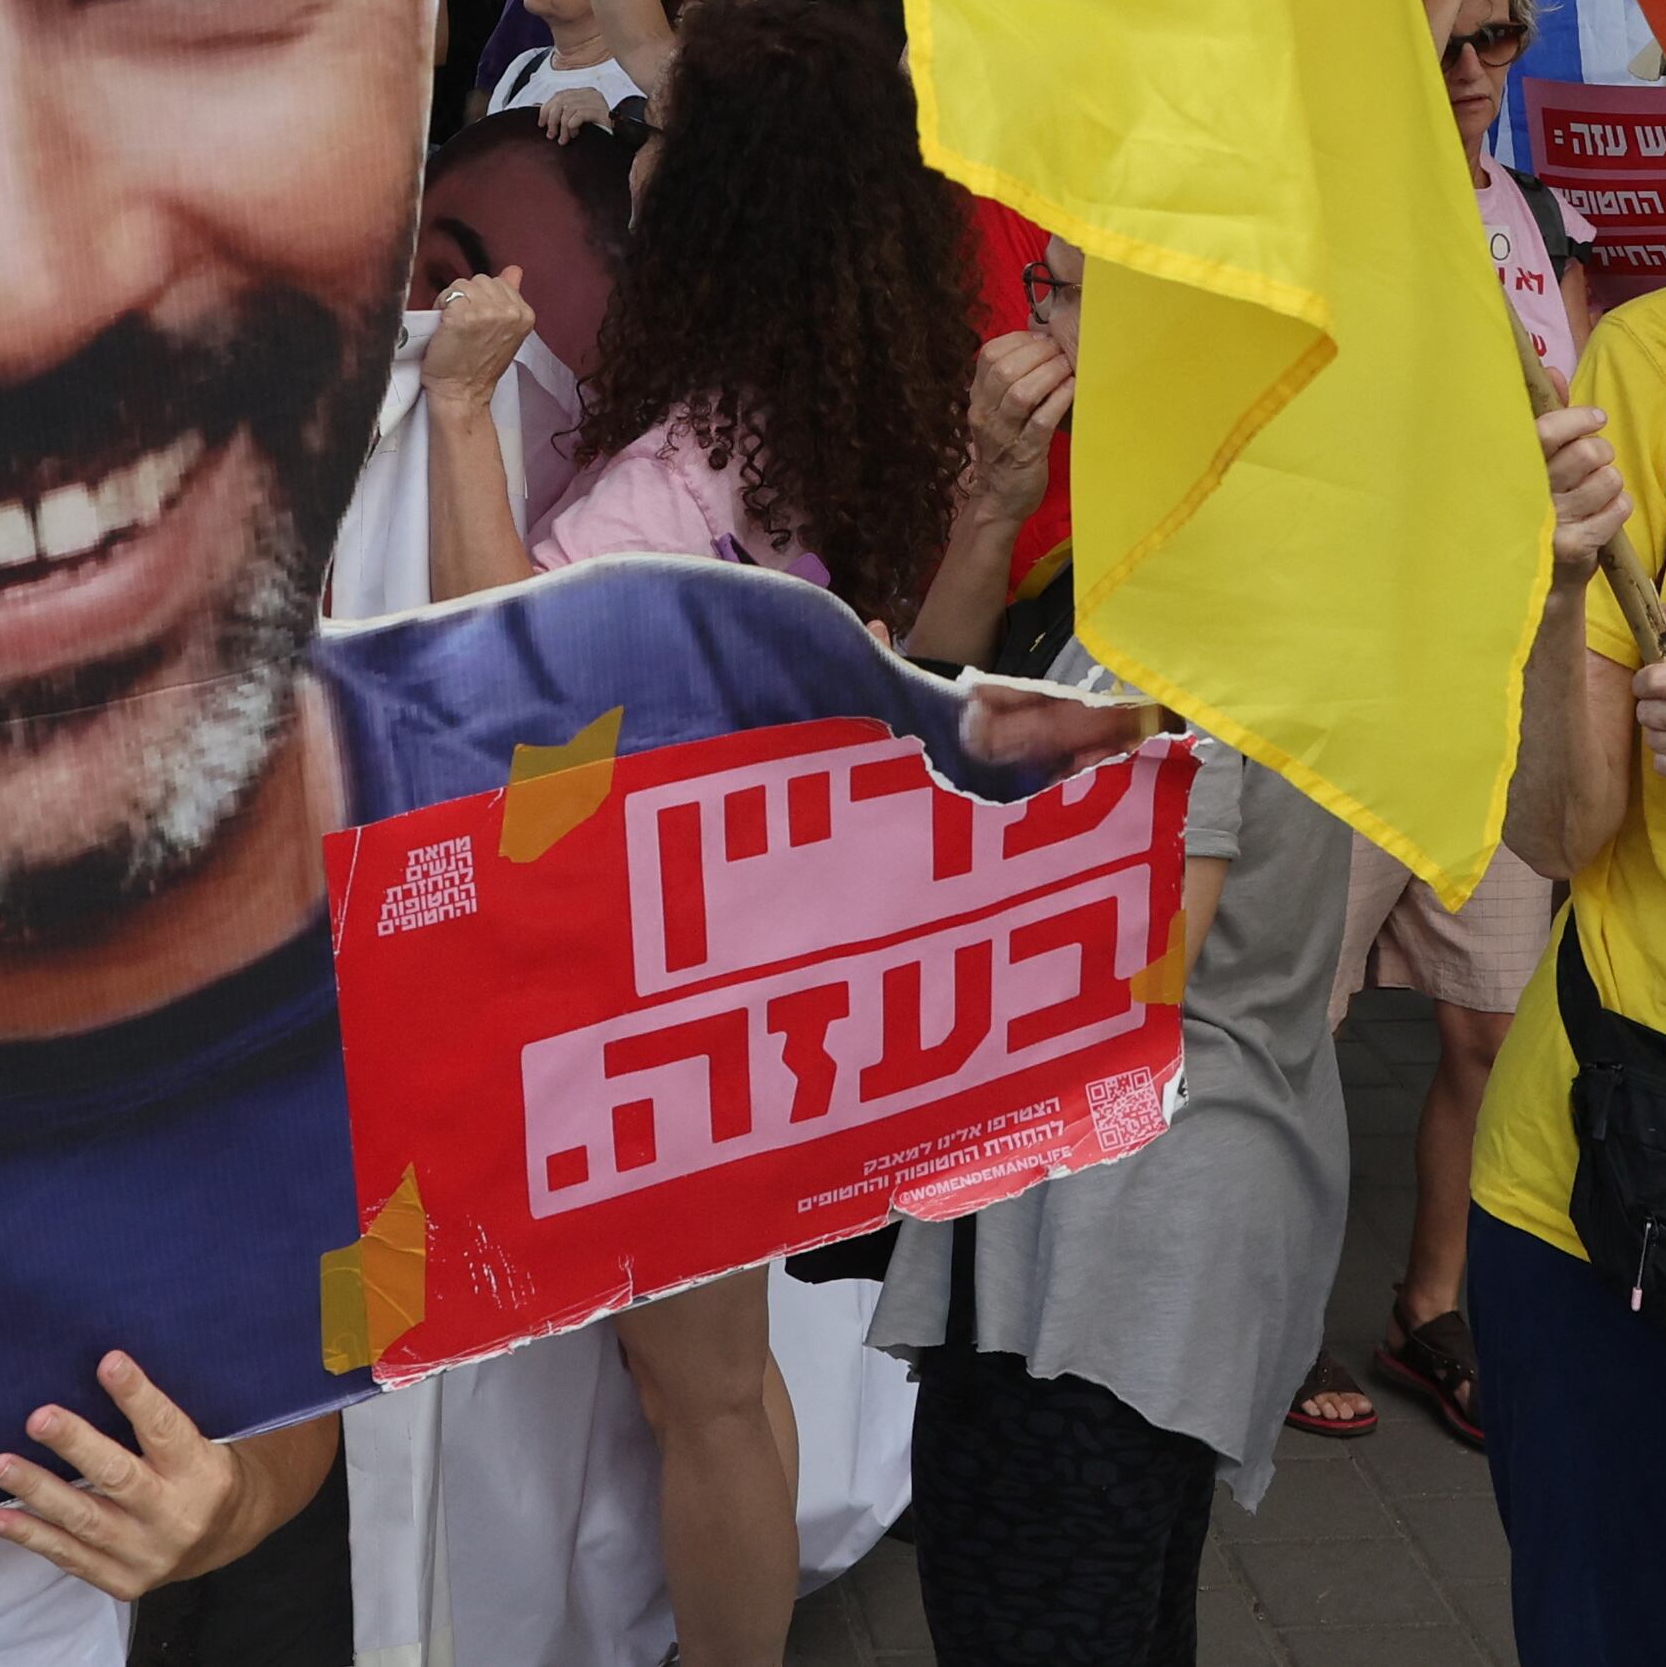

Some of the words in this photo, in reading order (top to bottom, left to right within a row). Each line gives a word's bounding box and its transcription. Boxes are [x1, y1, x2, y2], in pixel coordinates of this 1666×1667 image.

[405, 851, 473, 882] הנשים
[407, 835, 471, 866] מחאת
[380, 882, 476, 920] החטופות
[386, 866, 474, 903] להחזרת
[377, 897, 478, 937] והחטופים
[546, 896, 1132, 1191] בעזה.
[986, 1096, 1061, 1133] הצטרפו
[937, 1124, 982, 1151] אלינו
[983, 1119, 1065, 1158] להחזרת
[863, 1141, 932, 1176] למאבק
[894, 1145, 980, 1185] החטופות
[797, 1172, 889, 1214] והחטופים
